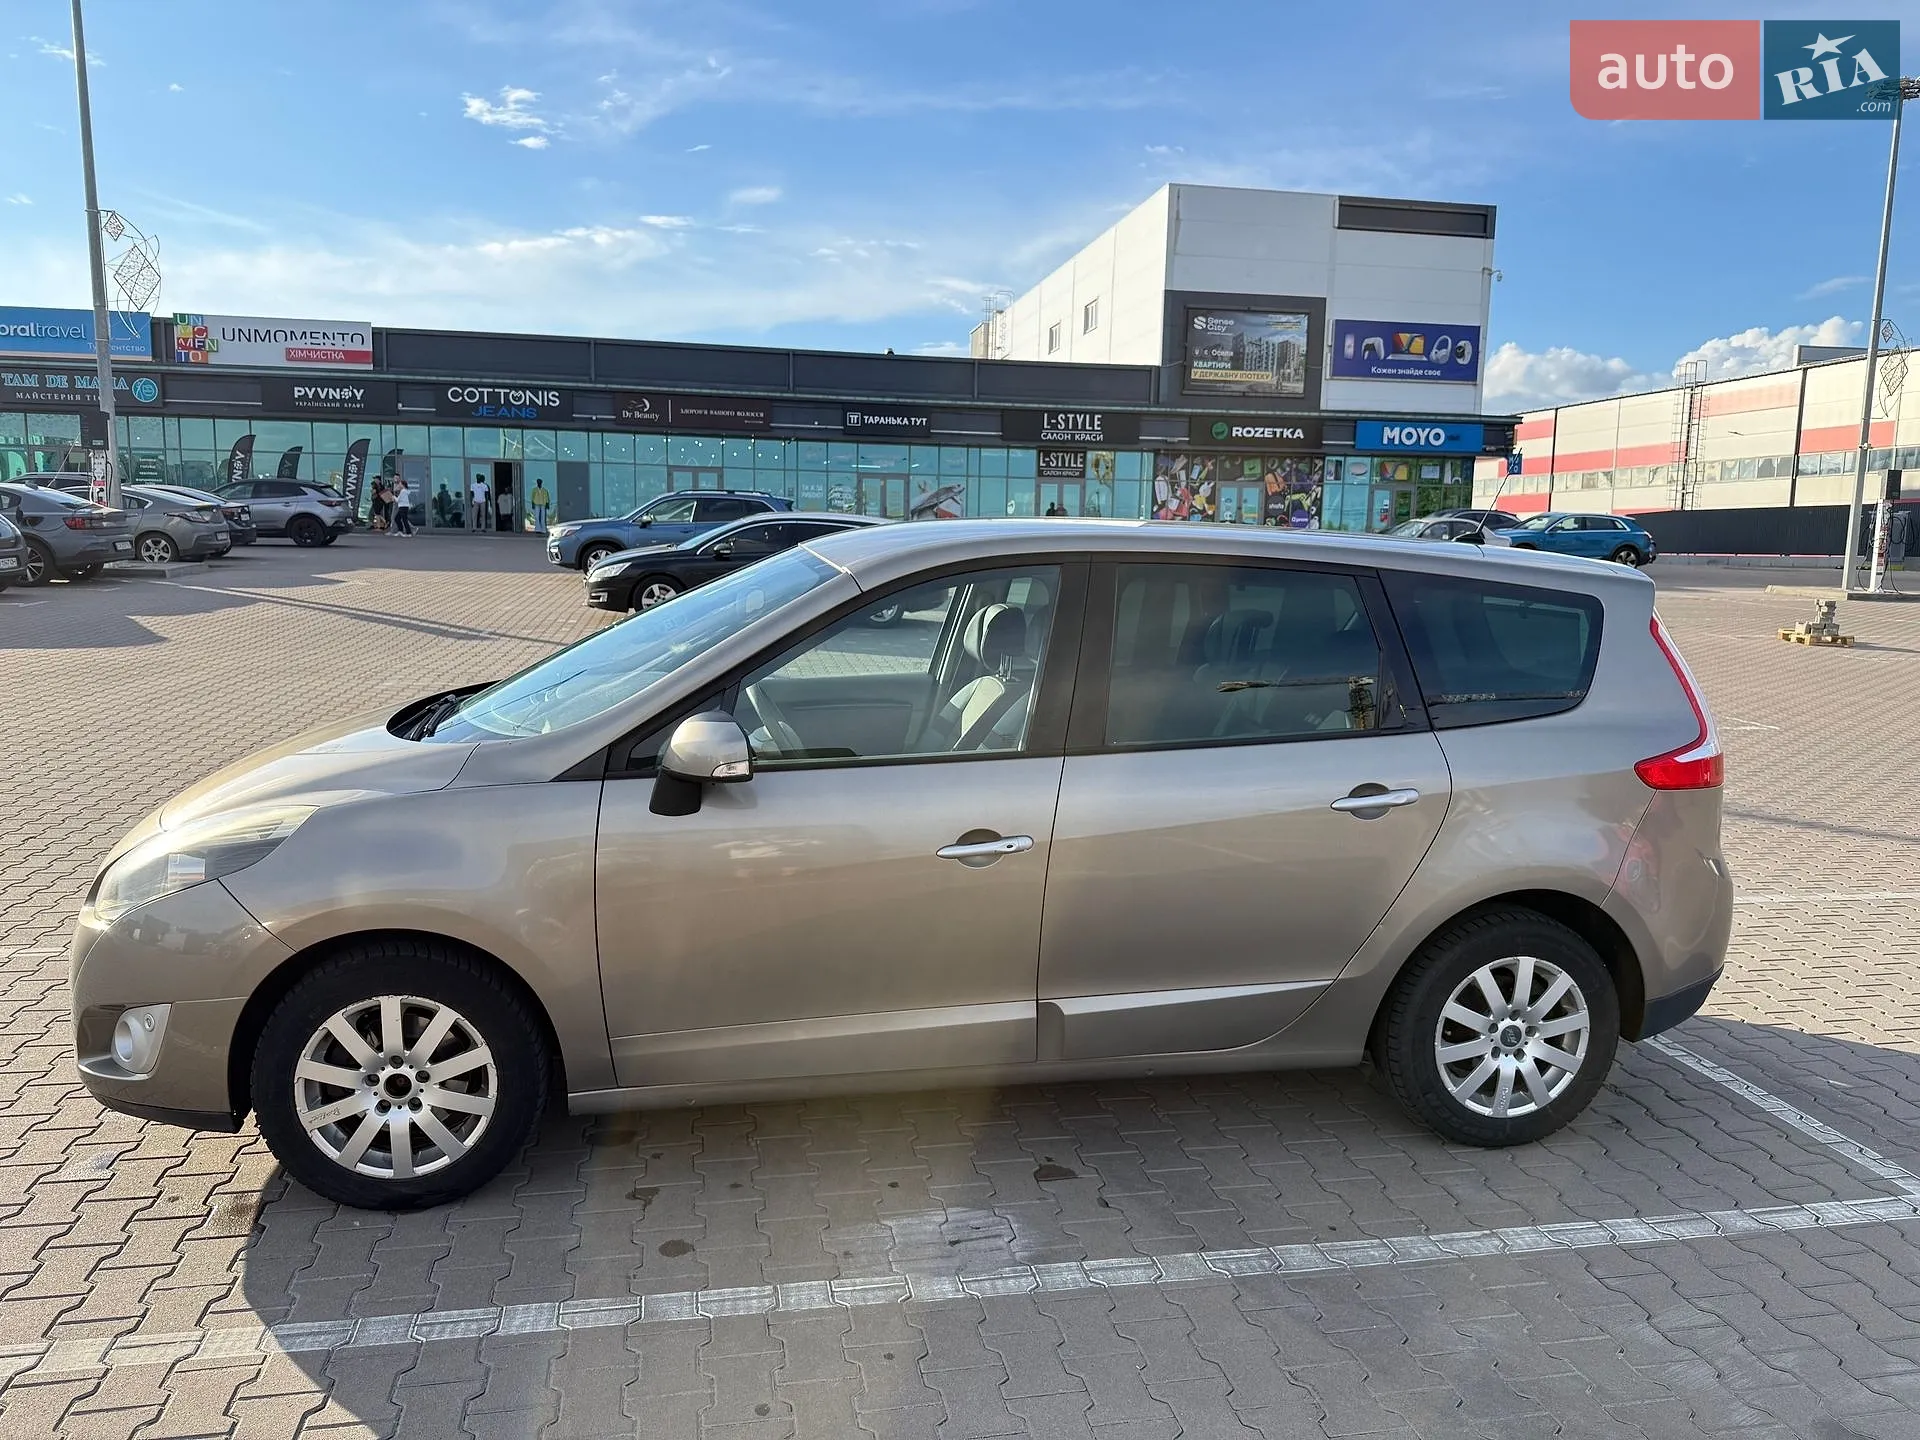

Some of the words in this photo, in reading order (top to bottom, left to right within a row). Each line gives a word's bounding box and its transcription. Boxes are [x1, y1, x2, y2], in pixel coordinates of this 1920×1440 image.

[1207, 317, 1234, 326] Sense
[1207, 325, 1227, 333] City
[222, 327, 365, 347] UNMOMENTO
[289, 349, 345, 360] ХІМЧИСТКА
[1193, 360, 1231, 369] КВАРТИРИ
[1199, 370, 1238, 379] ДЕРЖАВНУ
[1239, 372, 1270, 380] ІПОТЕКУ
[1371, 366, 1396, 374] Кожен
[1397, 367, 1423, 376] знайде
[75, 375, 129, 390] MAIA
[16, 392, 81, 401] МАЙСТЕРНЯ
[448, 386, 560, 407] COTTONIS
[472, 405, 537, 418] JEANS
[622, 410, 633, 419] Dr
[634, 411, 660, 422] Beauty
[863, 415, 909, 425] ТАРАНЬКА
[910, 417, 928, 426] ТУТ
[1043, 412, 1102, 430] L-STYLE
[1040, 432, 1071, 441] САЛОН
[1074, 433, 1104, 442] КРАСИ
[1231, 426, 1304, 439] ROZETKA
[1382, 426, 1446, 446] MOYO
[1039, 451, 1084, 468] L-STYLE
